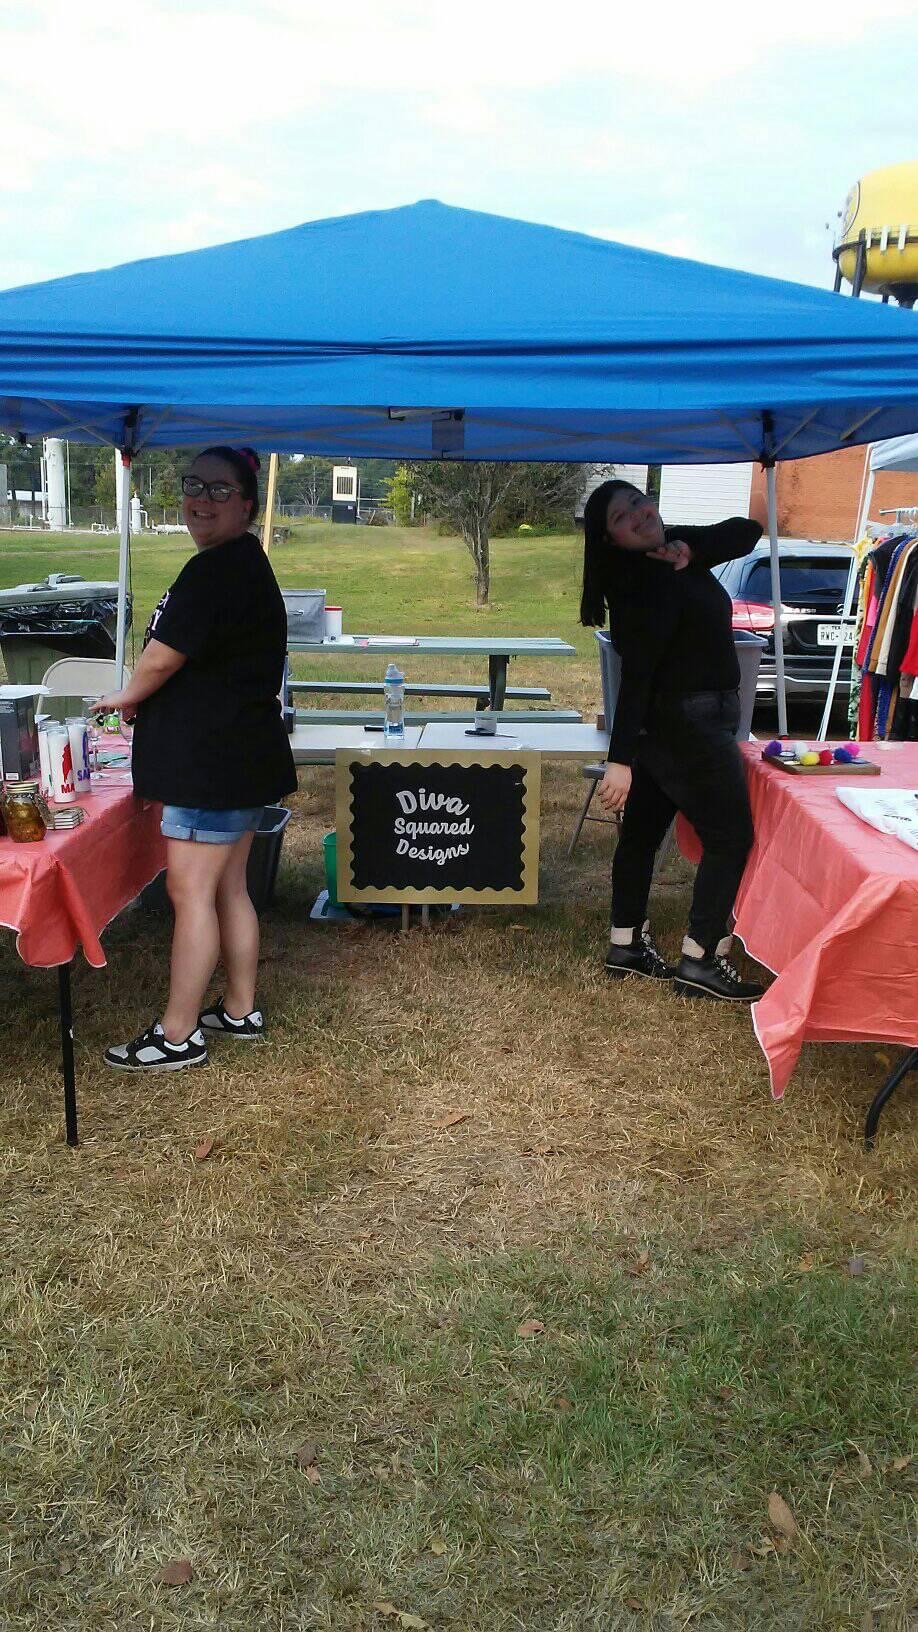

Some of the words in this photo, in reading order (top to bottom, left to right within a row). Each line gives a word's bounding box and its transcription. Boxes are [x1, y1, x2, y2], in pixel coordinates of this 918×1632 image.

[395, 788, 470, 816] Diva
[394, 817, 475, 840] Squared
[395, 838, 470, 865] Designs
